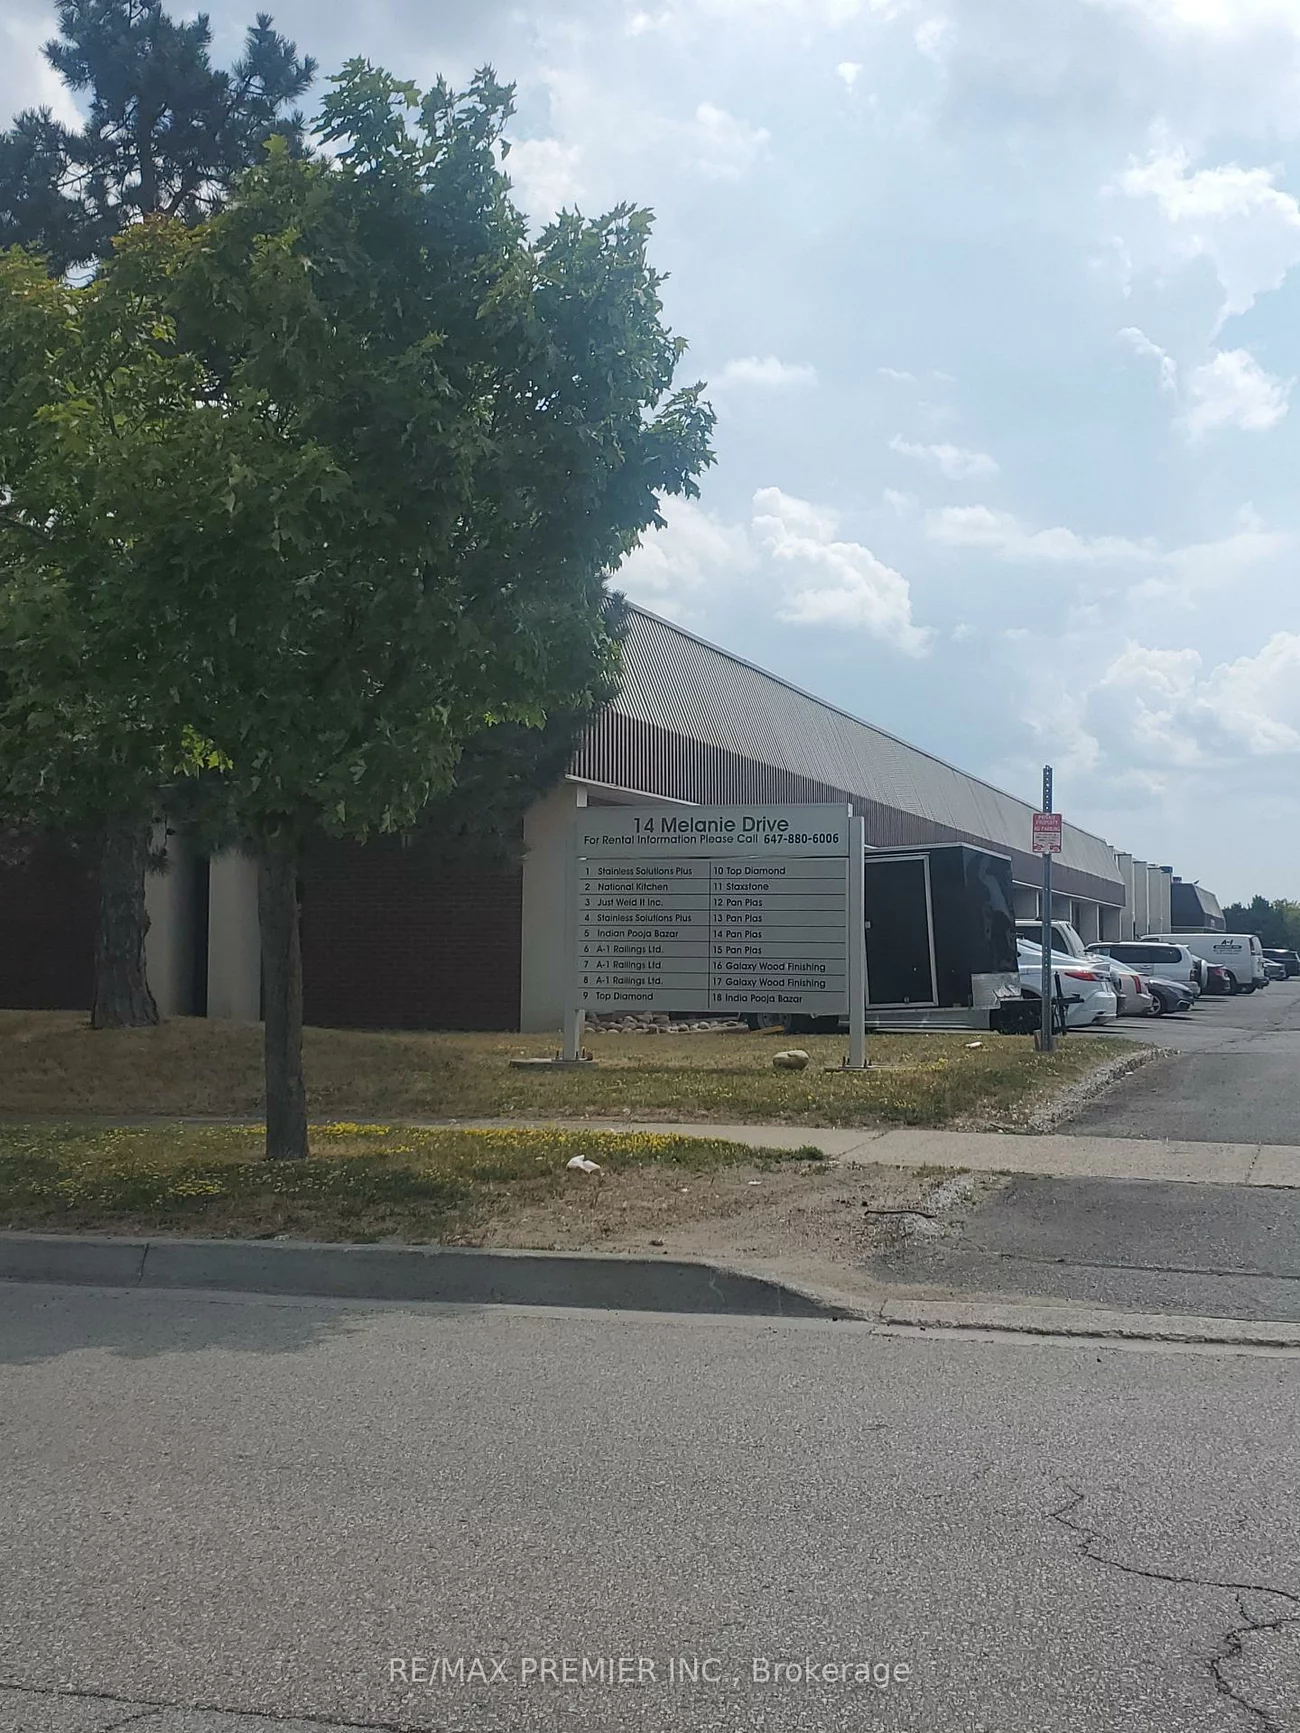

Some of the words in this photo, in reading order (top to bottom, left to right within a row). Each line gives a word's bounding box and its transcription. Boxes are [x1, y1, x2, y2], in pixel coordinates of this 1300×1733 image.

[634, 818, 655, 833] 14
[662, 817, 735, 833] Melanie
[743, 816, 789, 832] Drive
[584, 836, 600, 844] For
[602, 835, 634, 844] Rental
[638, 835, 696, 844] Information
[700, 834, 733, 843] Please
[737, 834, 758, 843] Call
[764, 834, 839, 844] 647-880-6006
[598, 867, 633, 875] Stainless
[636, 867, 673, 875] Solutions
[676, 867, 692, 875] Plus
[714, 867, 723, 875] 10
[726, 867, 742, 876] Top
[745, 867, 786, 875] Diamond
[616, 898, 637, 906] Weld
[597, 914, 633, 922] Stainless
[635, 914, 673, 922] Solutions
[675, 914, 691, 922] Plus
[714, 914, 722, 922] 13
[726, 914, 742, 922] Pan
[745, 914, 762, 922] Plas
[628, 930, 651, 939] Pooja
[713, 930, 722, 938] 14
[726, 930, 742, 938] Pan
[745, 930, 762, 938] Plas
[584, 945, 589, 953] 6
[596, 945, 610, 953] A-1
[614, 945, 646, 954] Railings
[713, 946, 722, 954] 15
[726, 946, 742, 954] Pan
[745, 946, 762, 954] Plas
[596, 961, 610, 969] A-1
[613, 961, 645, 970] Railings
[726, 962, 757, 971] Galaxy
[759, 962, 785, 970] Wood
[788, 963, 826, 972] Finishing
[583, 976, 588, 984] 8
[596, 976, 609, 984] A-1
[613, 976, 645, 986] Railings
[725, 978, 757, 987] Galaxy
[759, 978, 784, 986] Wood
[788, 979, 826, 988] Finishing
[596, 992, 611, 1001] Top
[614, 992, 654, 1000] Diamond
[713, 993, 722, 1001] 18
[725, 994, 747, 1002] India
[750, 994, 775, 1004] Pooja
[778, 995, 802, 1003] Bazar
